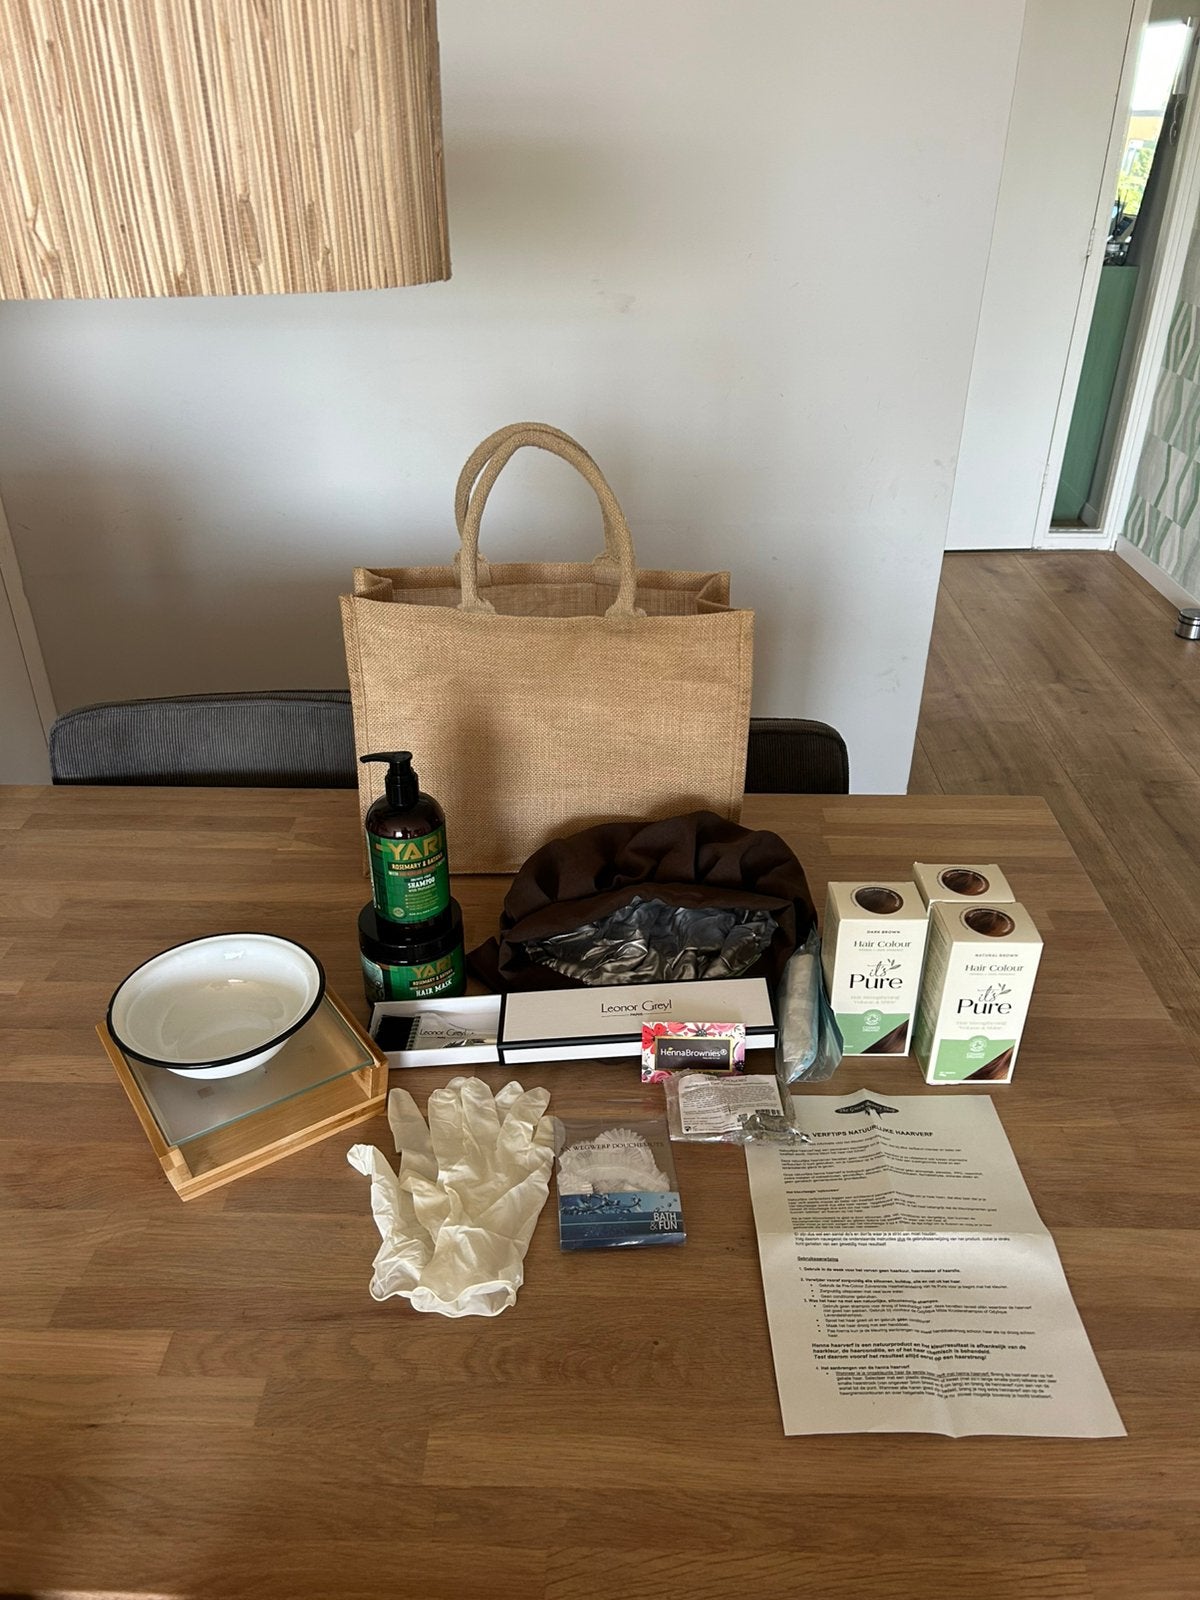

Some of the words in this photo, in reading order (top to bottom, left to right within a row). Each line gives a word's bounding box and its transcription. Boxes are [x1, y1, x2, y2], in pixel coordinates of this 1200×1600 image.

[853, 940, 875, 948] Hair
[877, 940, 912, 948] Colour
[965, 964, 987, 972] Hair
[989, 964, 1024, 972] Colour
[849, 973, 903, 990] Pure
[416, 987, 433, 997] HAIR
[434, 978, 452, 993] MASK
[601, 1003, 638, 1013] Leonor
[641, 999, 672, 1011] Greyl
[956, 998, 1012, 1015] Pure
[420, 1028, 444, 1036] Leonor
[446, 1028, 467, 1037] Greyl
[573, 1141, 611, 1152] WEGWERP
[653, 1212, 677, 1222] BATH
[649, 1221, 658, 1231] &
[658, 1221, 678, 1231] FUN
